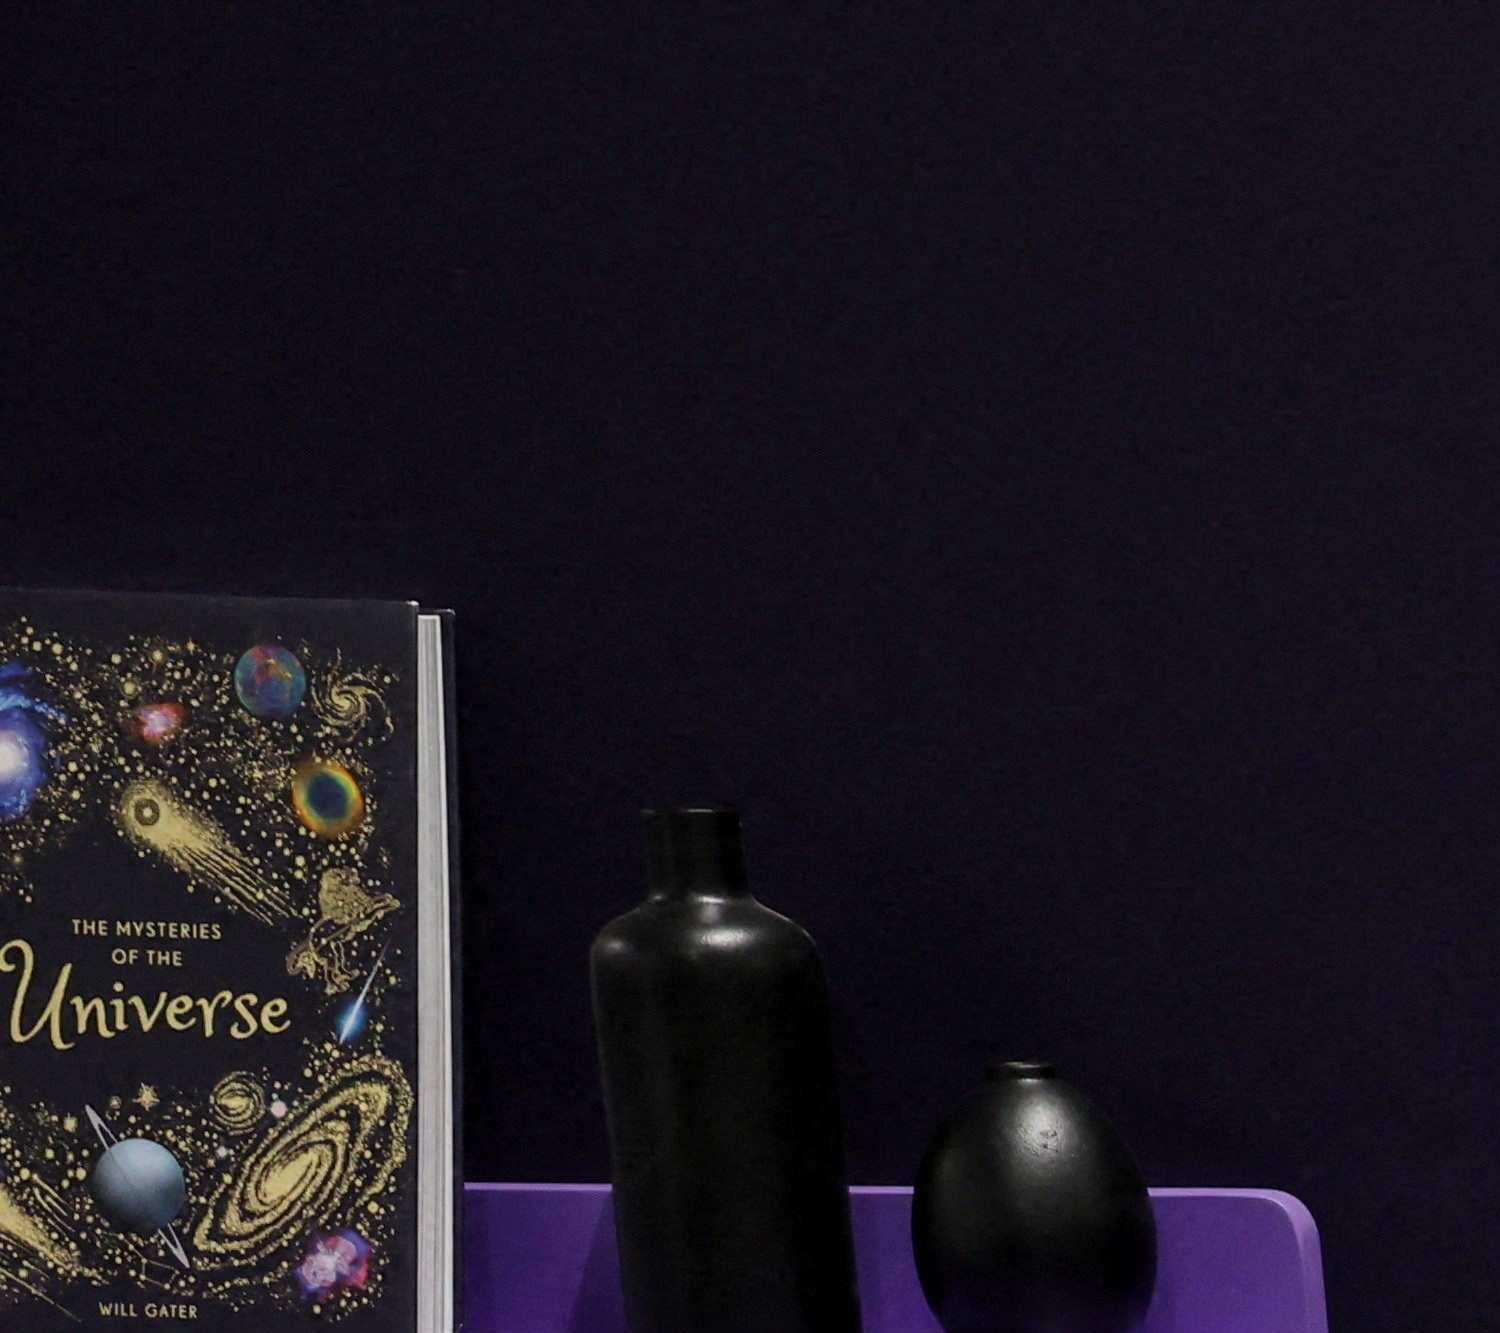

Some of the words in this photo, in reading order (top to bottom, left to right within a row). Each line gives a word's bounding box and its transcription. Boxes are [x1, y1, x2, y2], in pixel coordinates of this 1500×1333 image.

[72, 919, 107, 936] THE
[117, 921, 222, 940] MYSTERIES
[112, 949, 138, 965] OF
[147, 949, 183, 967] THE
[0, 939, 291, 1050] Universe
[99, 1302, 138, 1317] WILL
[145, 1303, 198, 1319] GATER
